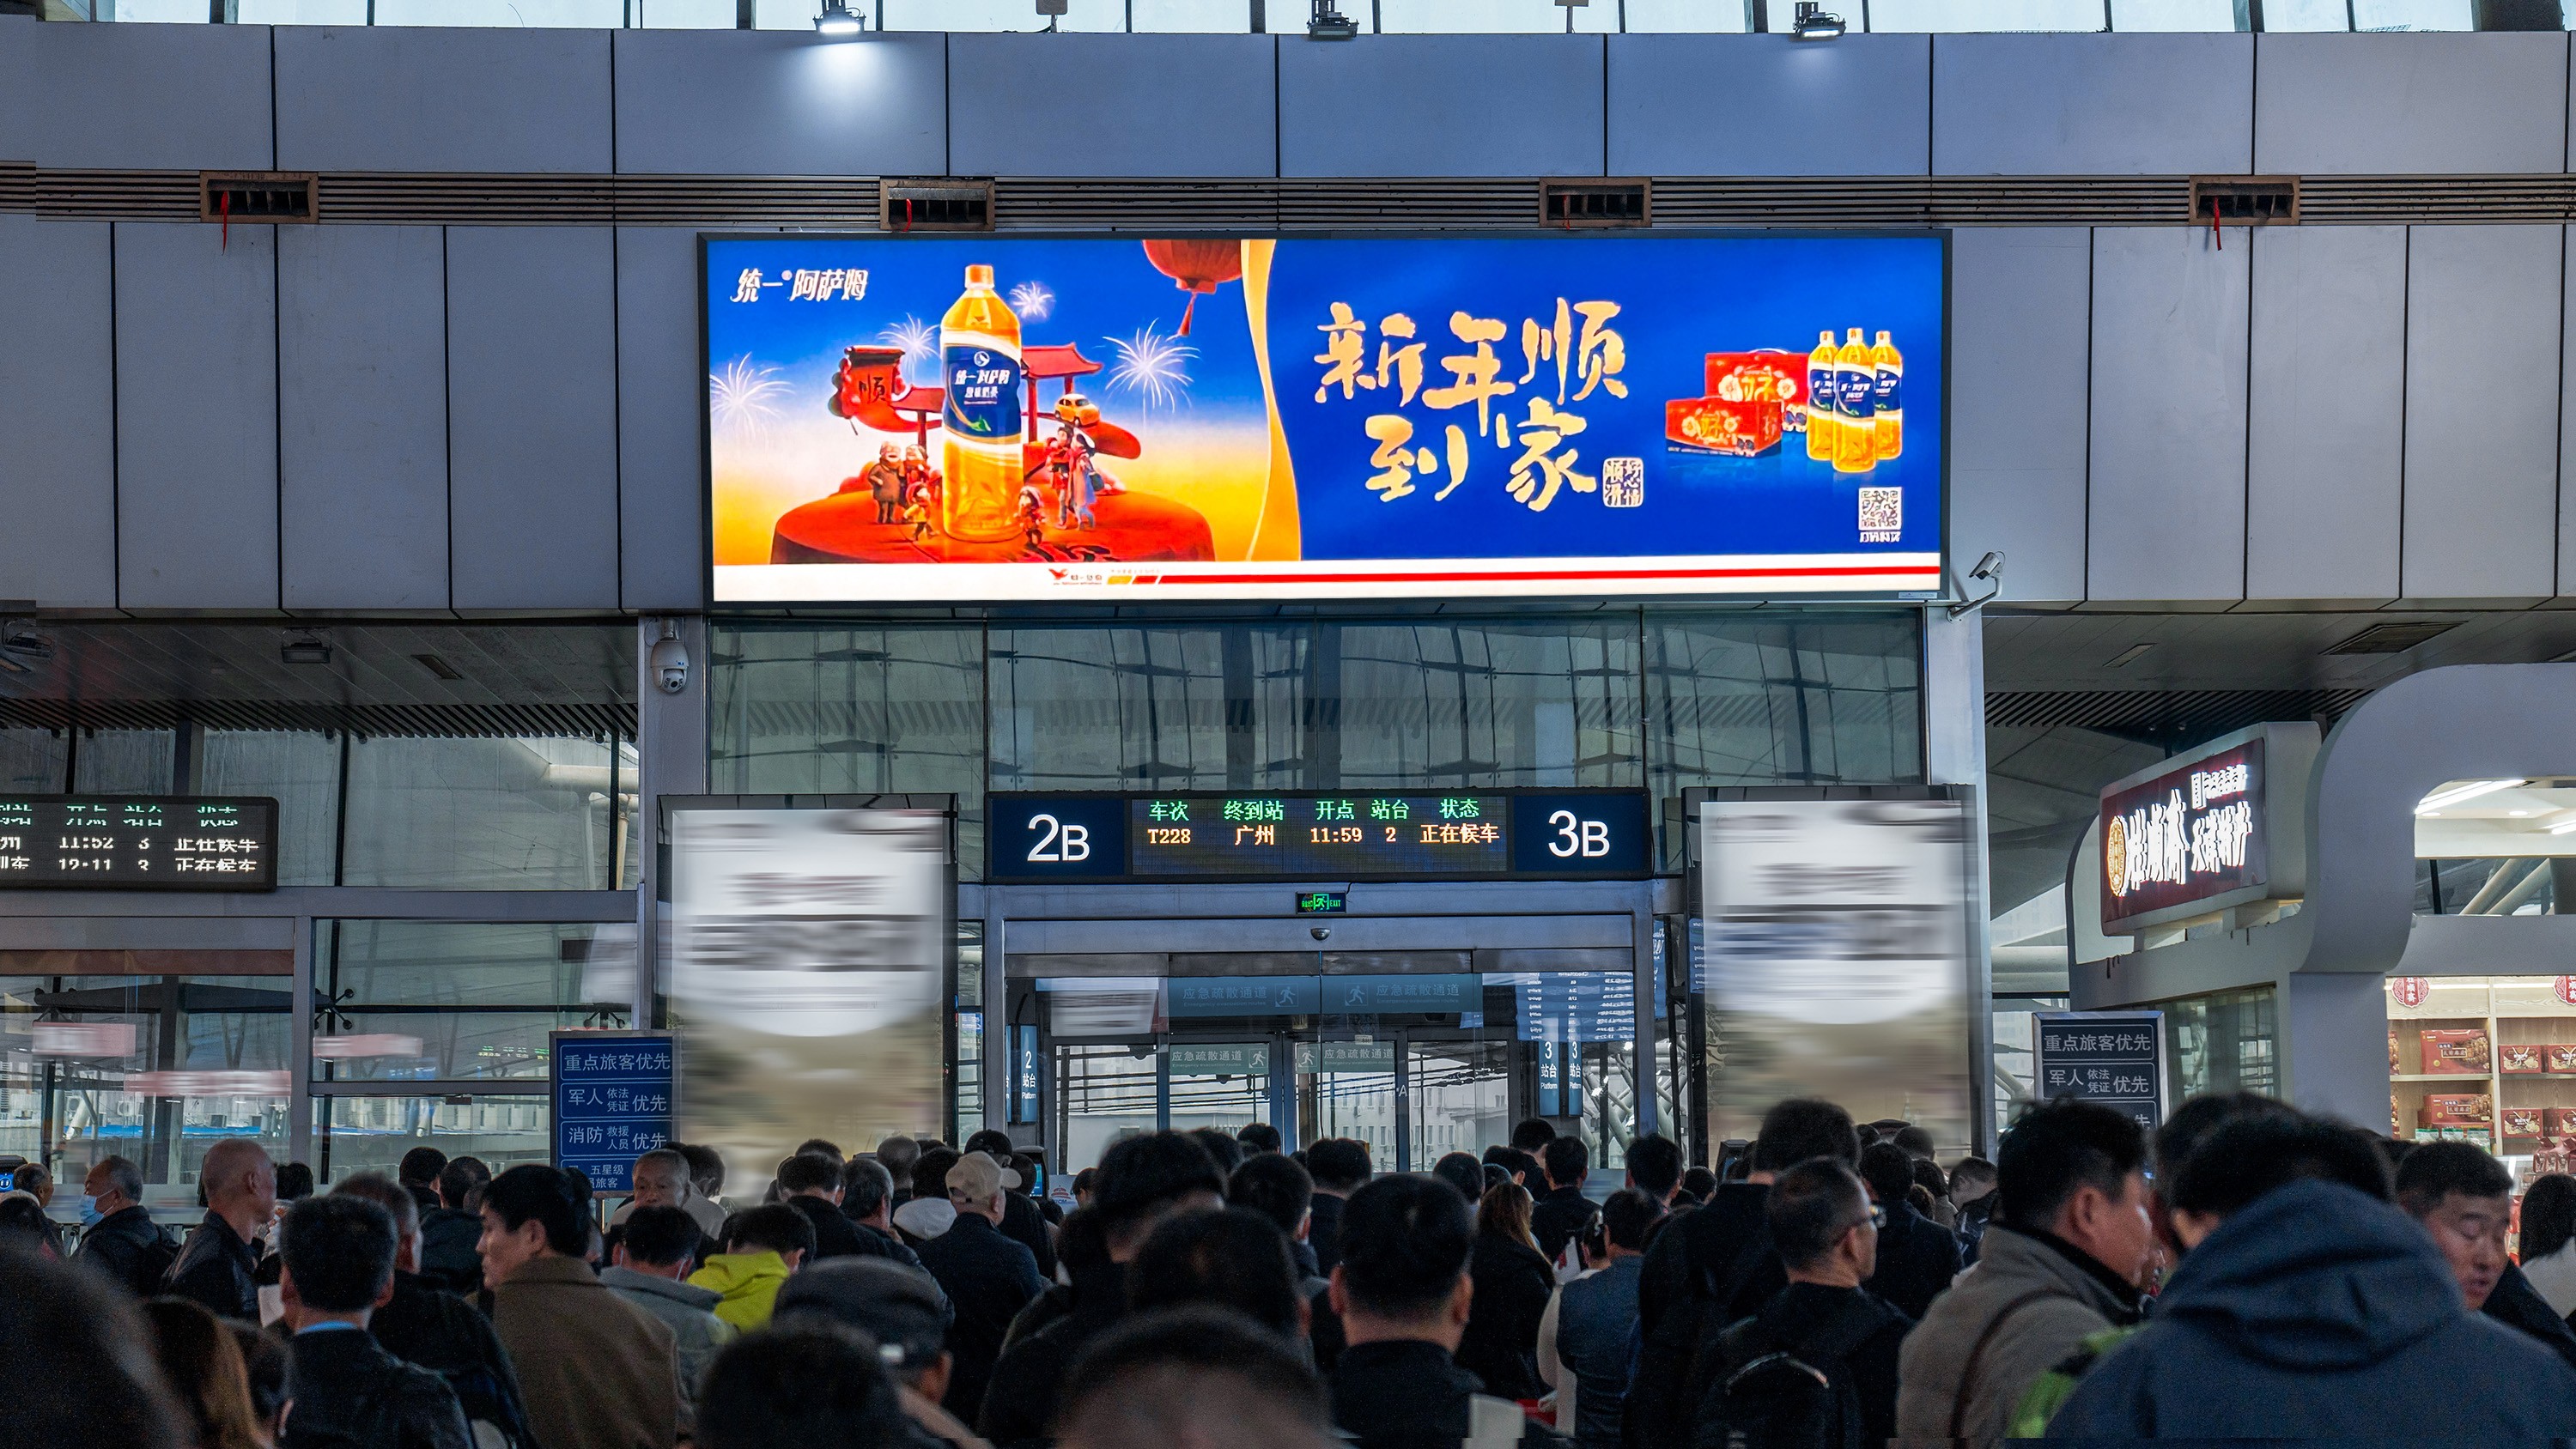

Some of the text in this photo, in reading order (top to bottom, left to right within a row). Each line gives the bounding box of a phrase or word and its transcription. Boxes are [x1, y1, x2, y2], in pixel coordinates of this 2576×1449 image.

[1365, 397, 1596, 512] 到家
[1149, 798, 1479, 822] 车次 终到站 开点 站台 状态
[1027, 814, 1091, 862] 2B
[1147, 823, 1500, 846] T228 广州 11:59 2 正在候车
[1548, 809, 1611, 857] 3B
[1183, 986, 1267, 999] 应急疏散通道
[1376, 983, 1459, 997] 应急疏散通道
[1545, 1041, 1552, 1059] 3
[1571, 1041, 1578, 1059] 3
[2044, 1034, 2151, 1052] 重点旅客优先
[564, 1052, 671, 1071] 重点旅客优先
[1025, 1051, 1032, 1069] 2
[1172, 1050, 1242, 1062] 应急疏散通道
[1324, 1048, 1394, 1059] 应急疏散通道
[1540, 1063, 1557, 1078] 站台
[1570, 1063, 1582, 1078] 站台
[1022, 1073, 1036, 1088] 站台
[2049, 1069, 2149, 1094] 军人 依法 凭证 优先
[568, 1088, 667, 1113] 军人 依法 凭证 优先
[568, 1125, 667, 1150] 消防 救援 人员 优先
[590, 1165, 624, 1176] 五星级
